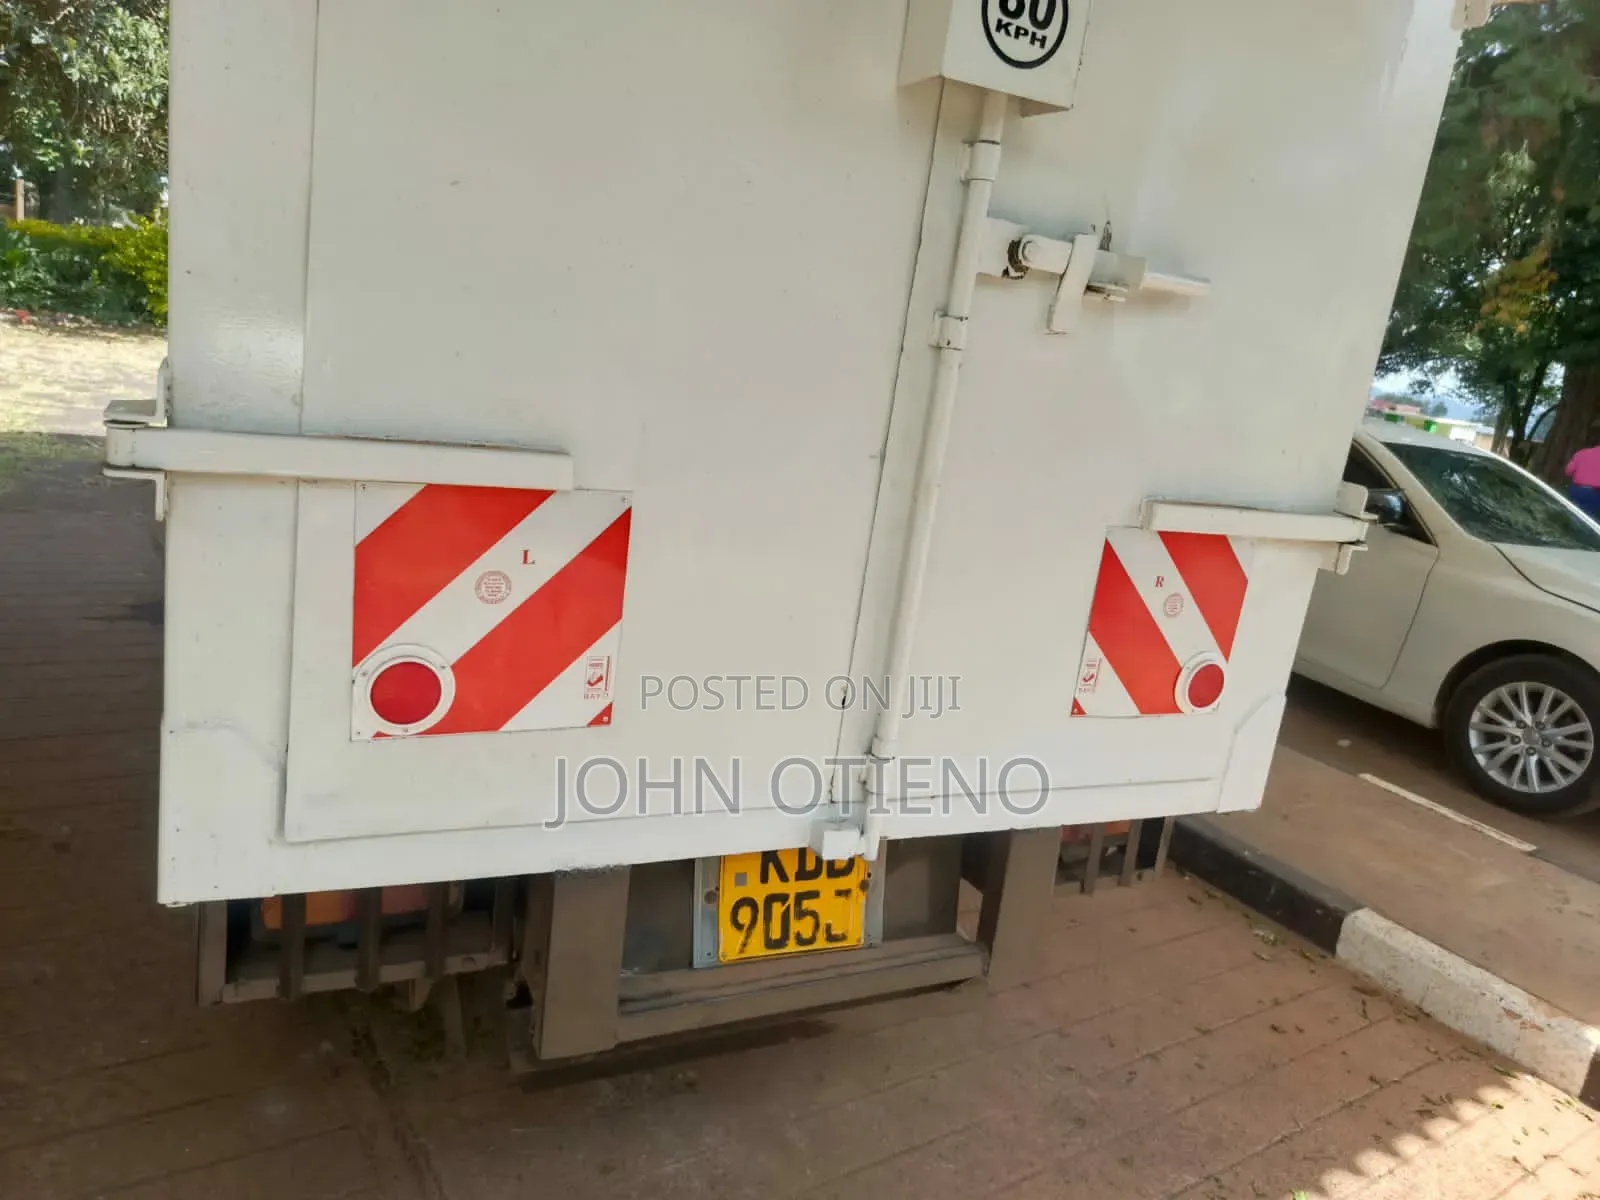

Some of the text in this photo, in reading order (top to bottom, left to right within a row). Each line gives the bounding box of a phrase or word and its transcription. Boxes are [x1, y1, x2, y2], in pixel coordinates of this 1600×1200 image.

[996, 18, 1048, 49] KPH
[520, 549, 536, 565] L
[1155, 575, 1165, 588] R
